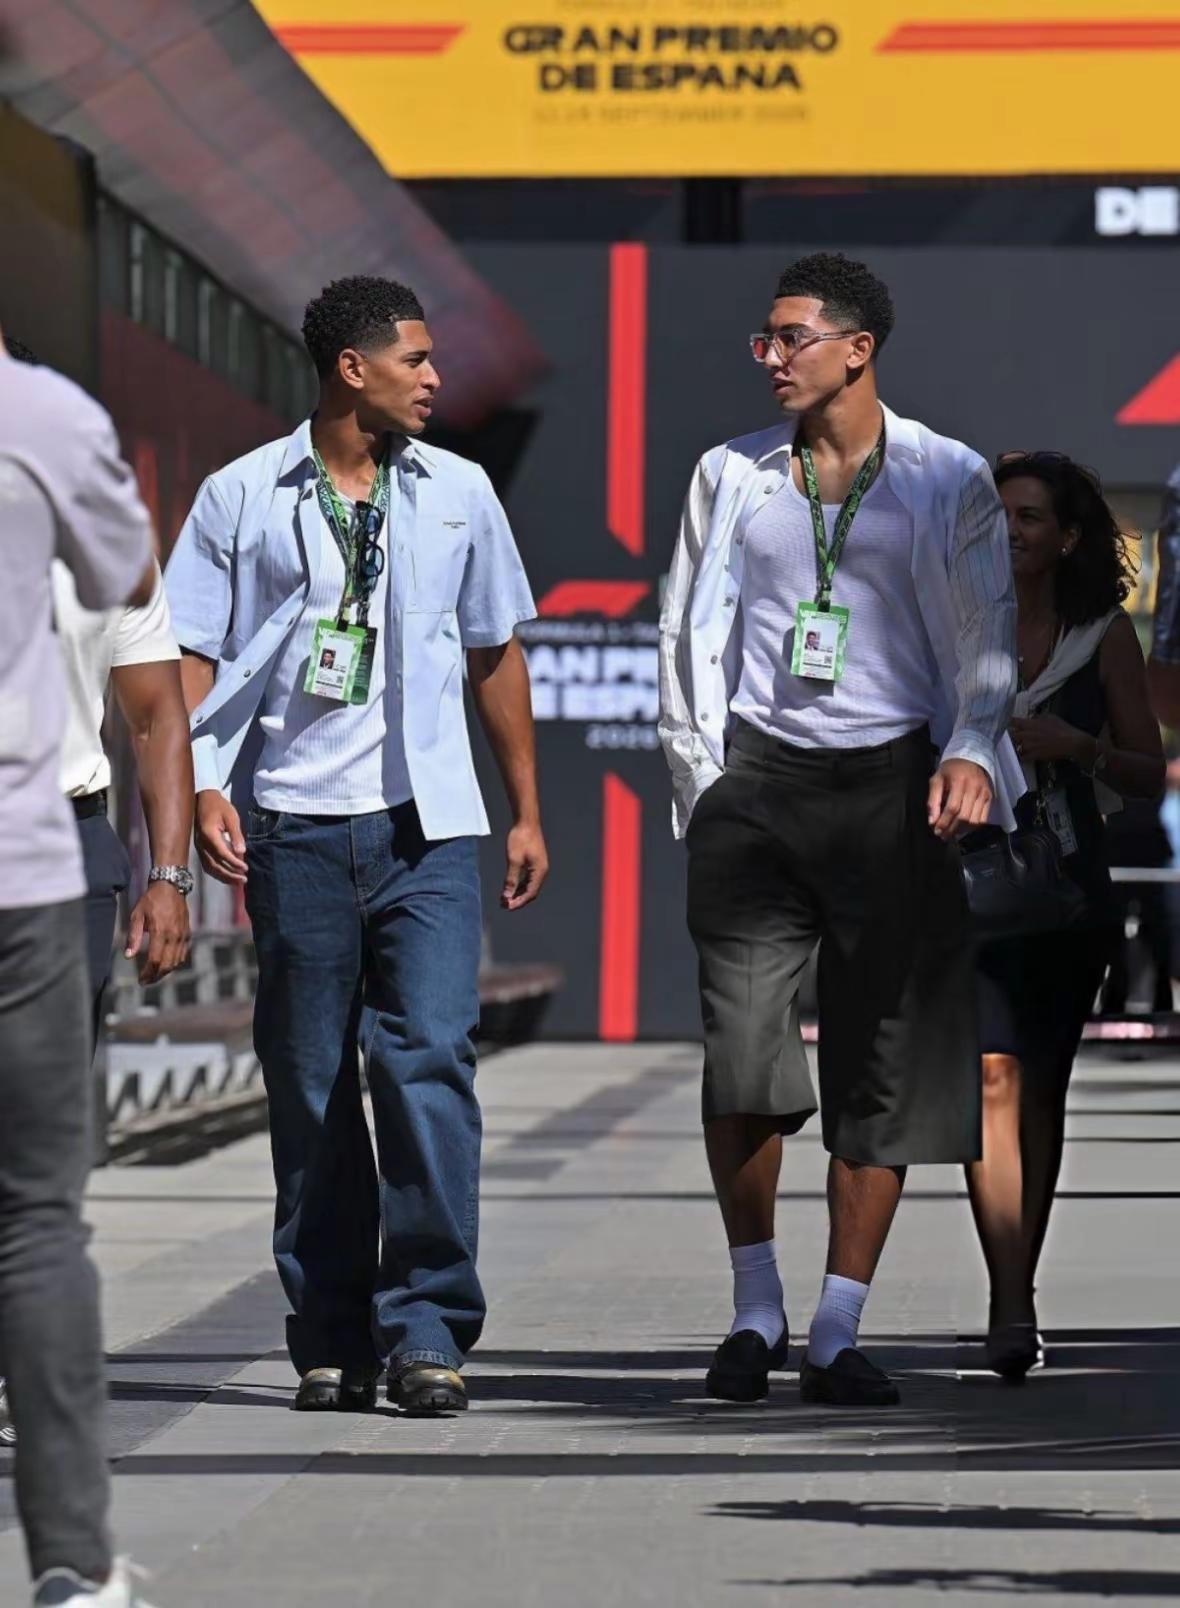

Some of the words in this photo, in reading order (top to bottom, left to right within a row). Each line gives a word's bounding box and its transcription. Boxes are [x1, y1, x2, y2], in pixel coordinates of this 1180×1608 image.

[503, 24, 642, 54] GRAN
[652, 24, 839, 54] PREMIO
[538, 63, 598, 92] DE
